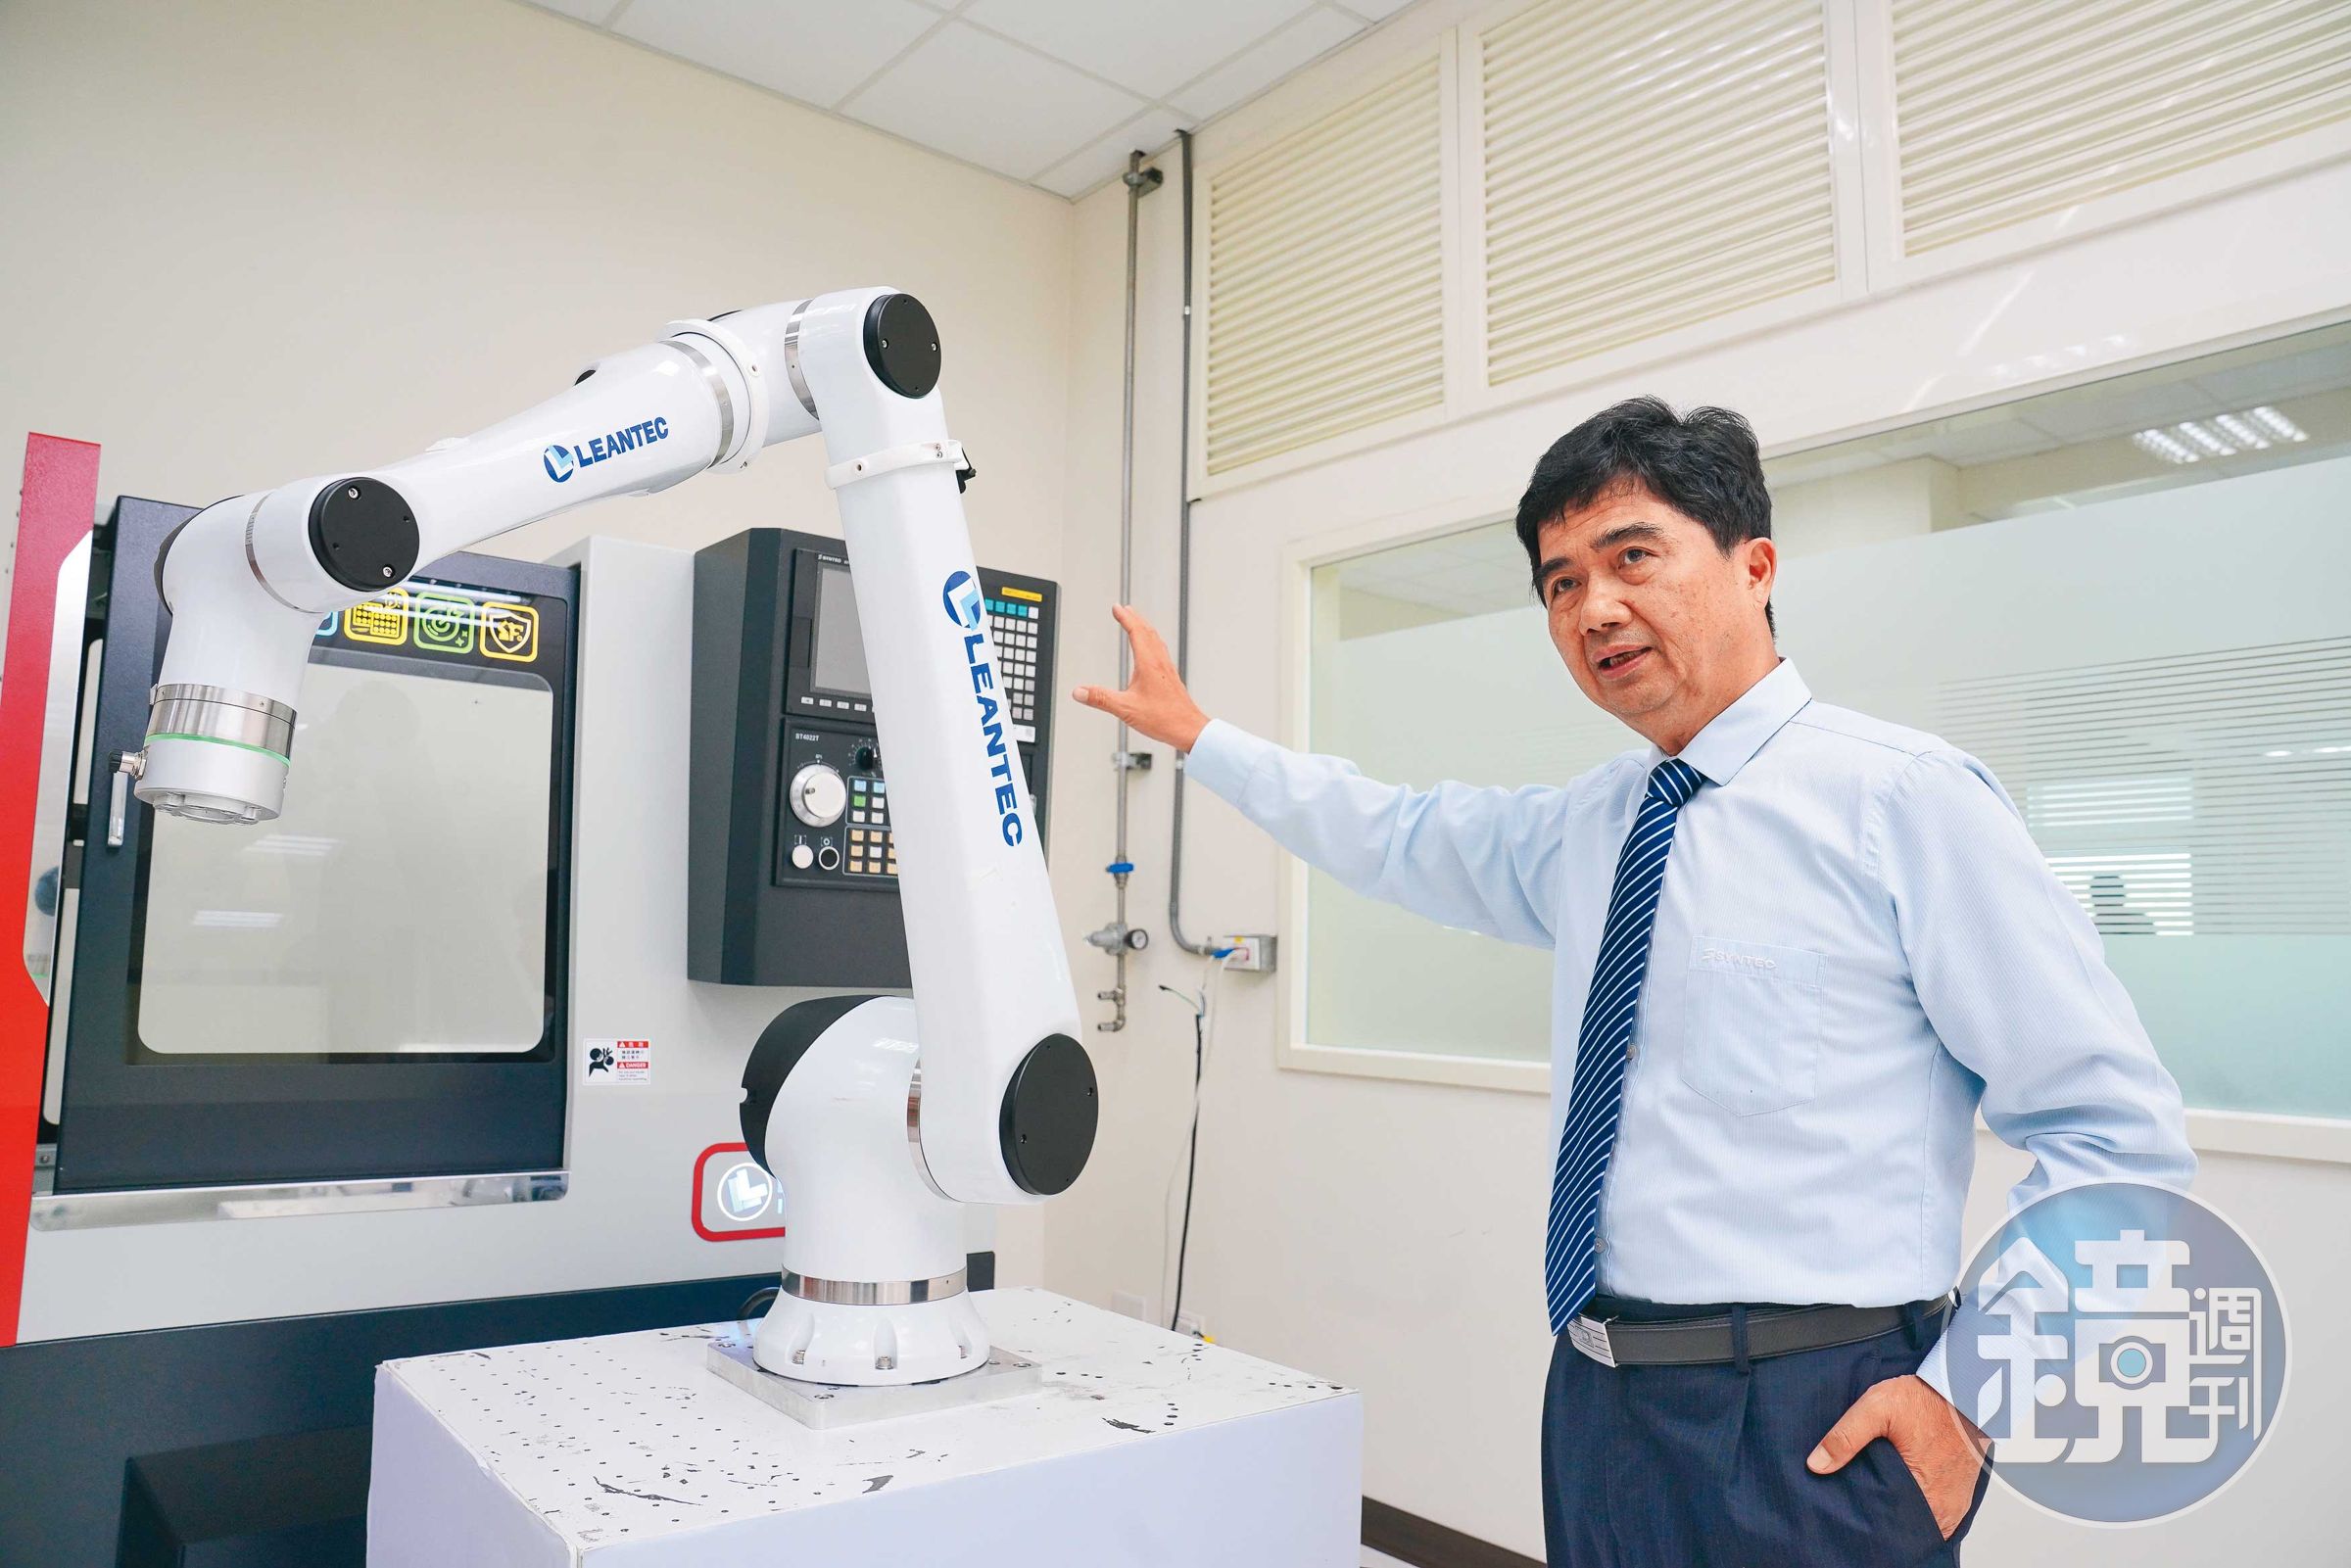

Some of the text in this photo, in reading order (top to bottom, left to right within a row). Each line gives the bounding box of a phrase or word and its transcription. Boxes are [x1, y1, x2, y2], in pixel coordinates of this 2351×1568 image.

[573, 416, 669, 468] LEANTEC
[964, 633, 1023, 847] LEANTEC
[1714, 949, 1777, 970] SYNTEC
